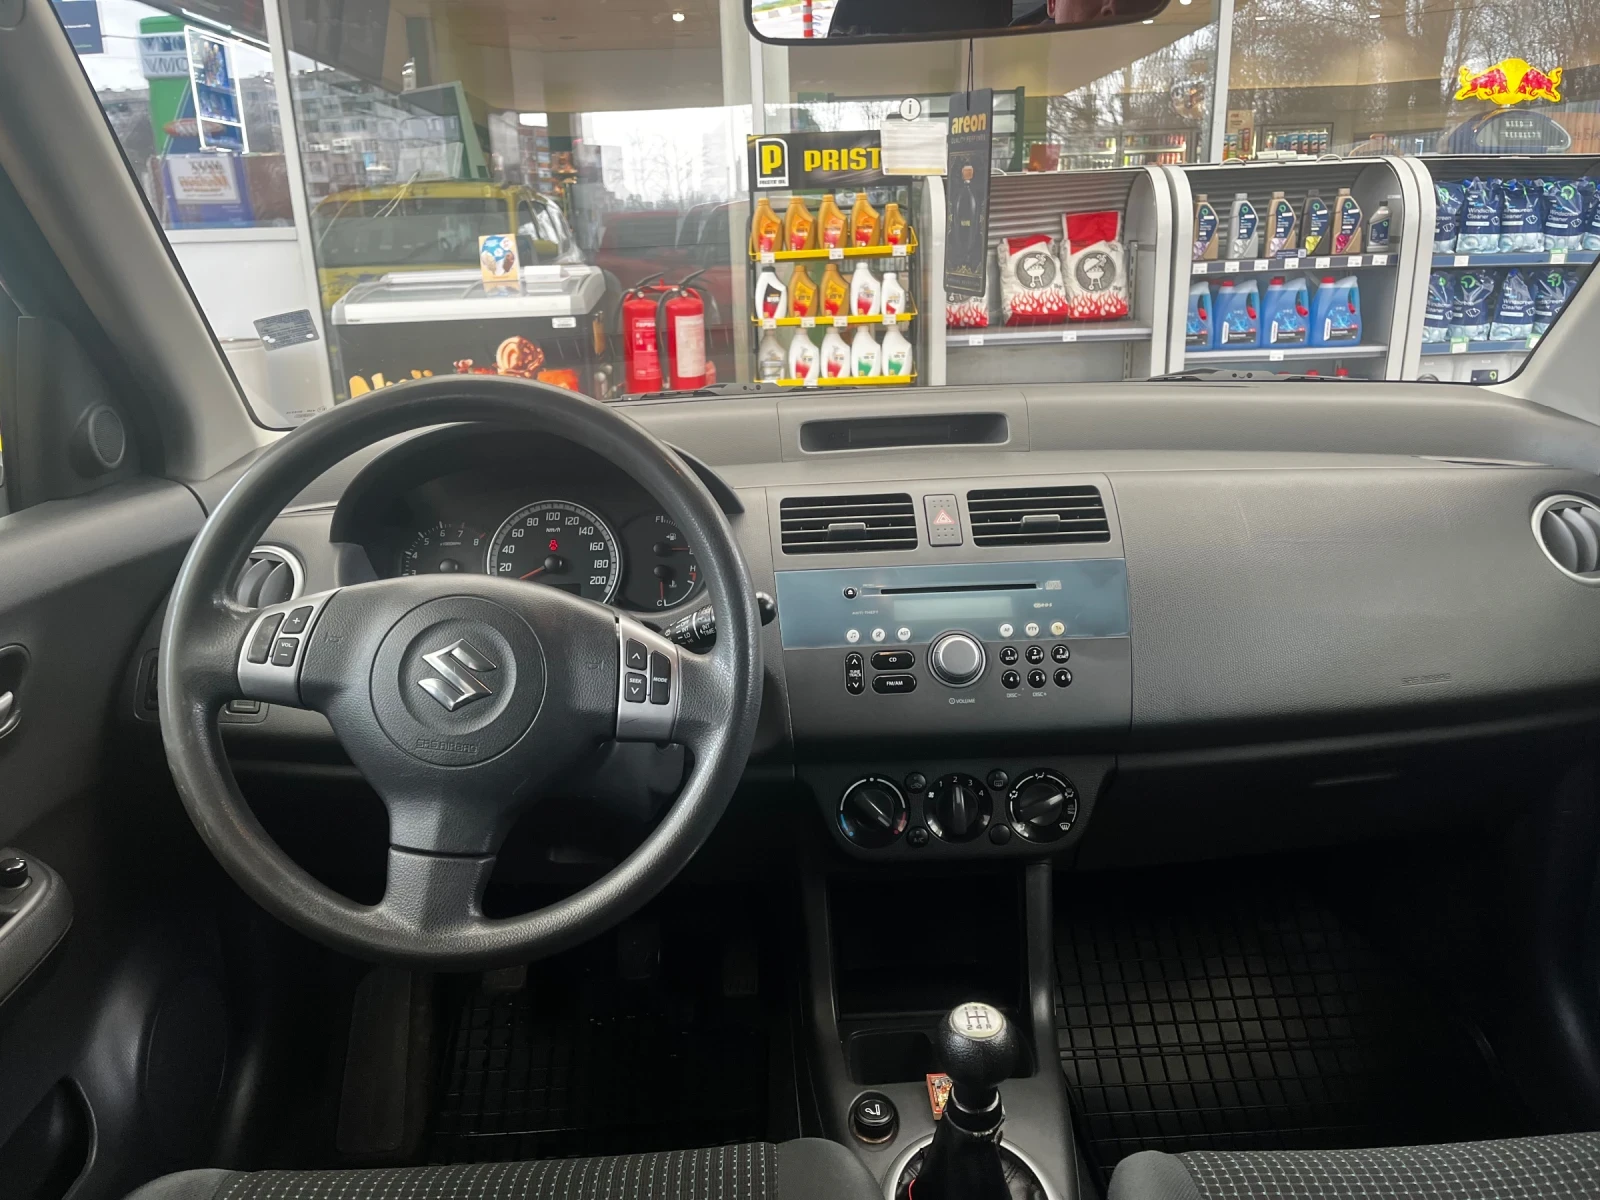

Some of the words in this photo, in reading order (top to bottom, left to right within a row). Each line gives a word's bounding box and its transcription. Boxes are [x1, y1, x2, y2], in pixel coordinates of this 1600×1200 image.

[951, 113, 986, 135] areon
[761, 145, 782, 174] P
[546, 512, 560, 520] 100
[565, 516, 579, 525] 120
[527, 518, 539, 526] 80
[512, 529, 524, 537] 60
[579, 526, 593, 536] 140
[474, 538, 479, 546] 8
[590, 542, 604, 551] 160
[502, 545, 515, 554] 40
[500, 563, 512, 572] 20
[594, 560, 609, 569] 180
[590, 576, 606, 585] 200
[968, 779, 973, 787] 3
[978, 789, 984, 797] 4
